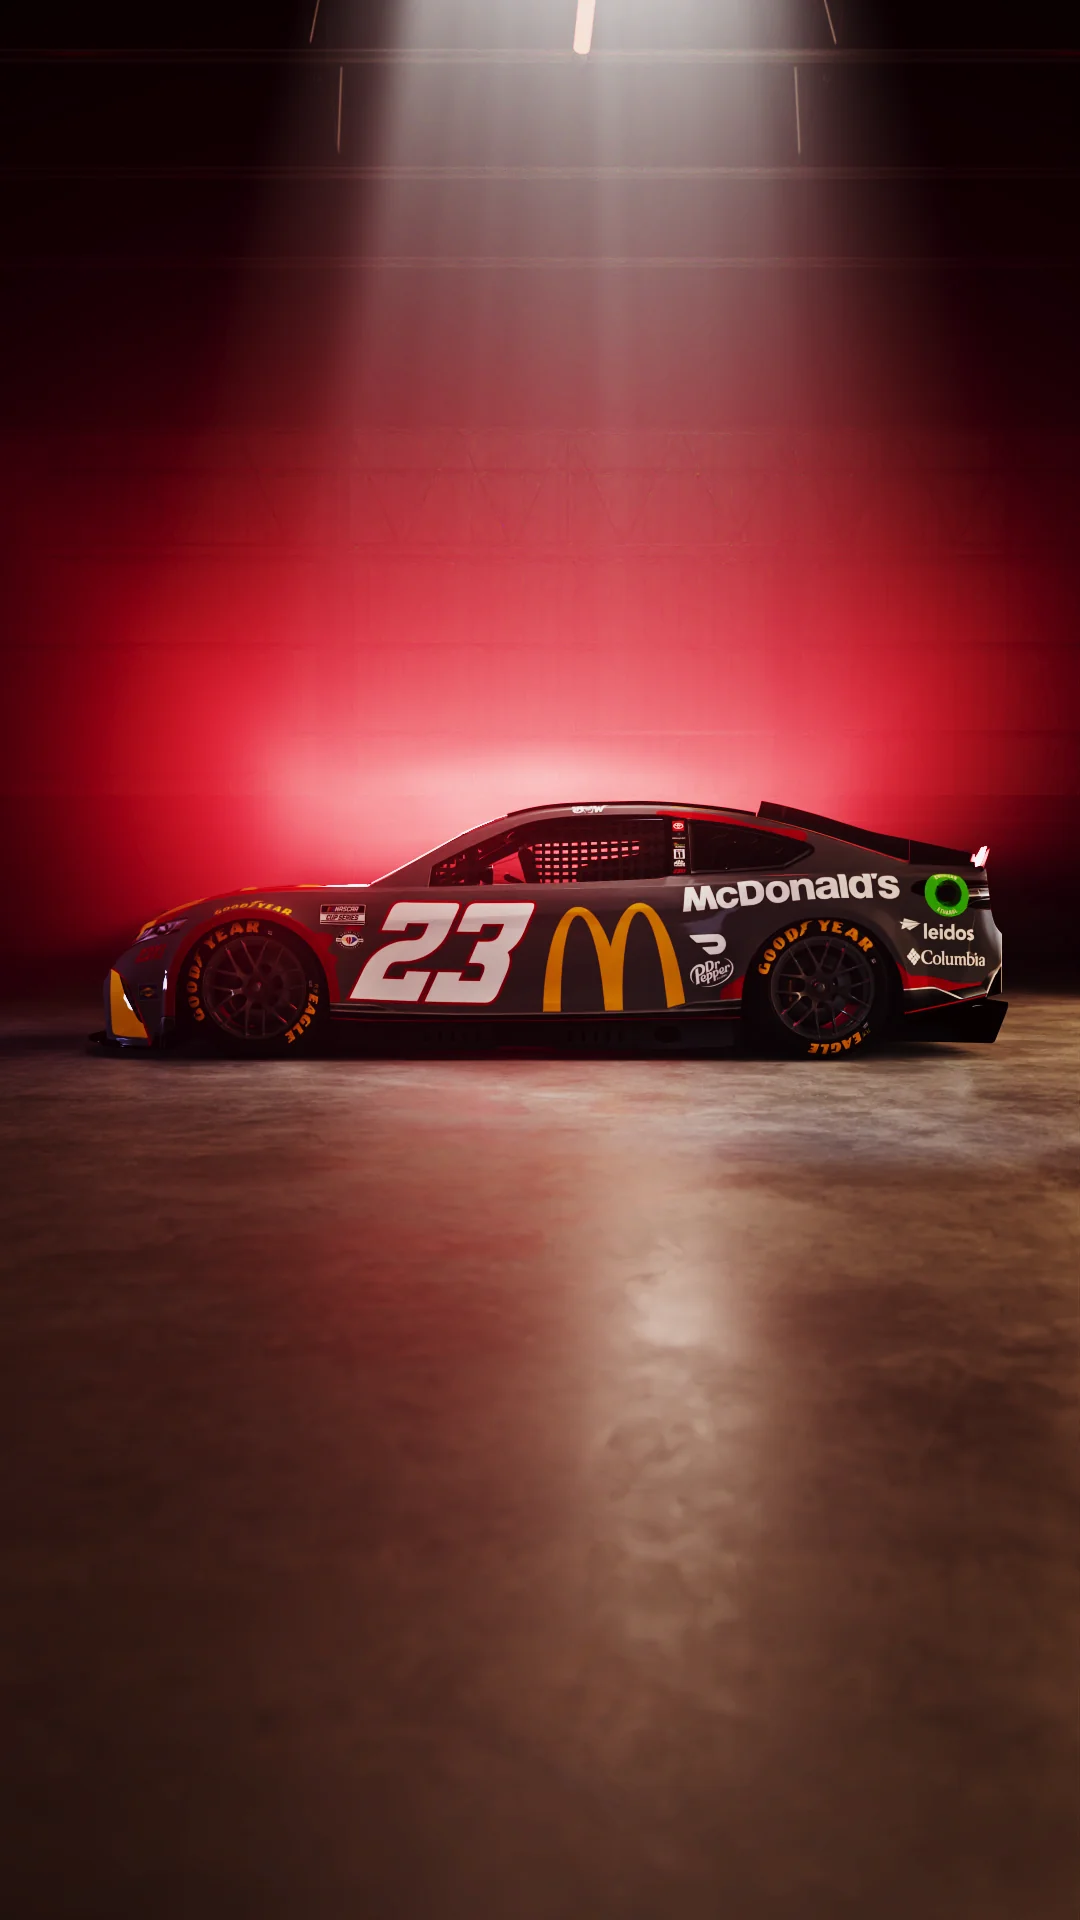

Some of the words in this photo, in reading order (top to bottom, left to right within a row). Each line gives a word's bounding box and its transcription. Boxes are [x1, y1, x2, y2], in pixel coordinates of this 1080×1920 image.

[682, 873, 901, 913] McDonald's
[923, 922, 975, 942] leidos
[349, 900, 536, 1005] 23
[920, 949, 986, 967] Columbia
[690, 963, 731, 986] Pepper
[704, 960, 721, 973] Dr
[284, 993, 320, 1044] EAGLE
[807, 1031, 862, 1055] EAGLE
